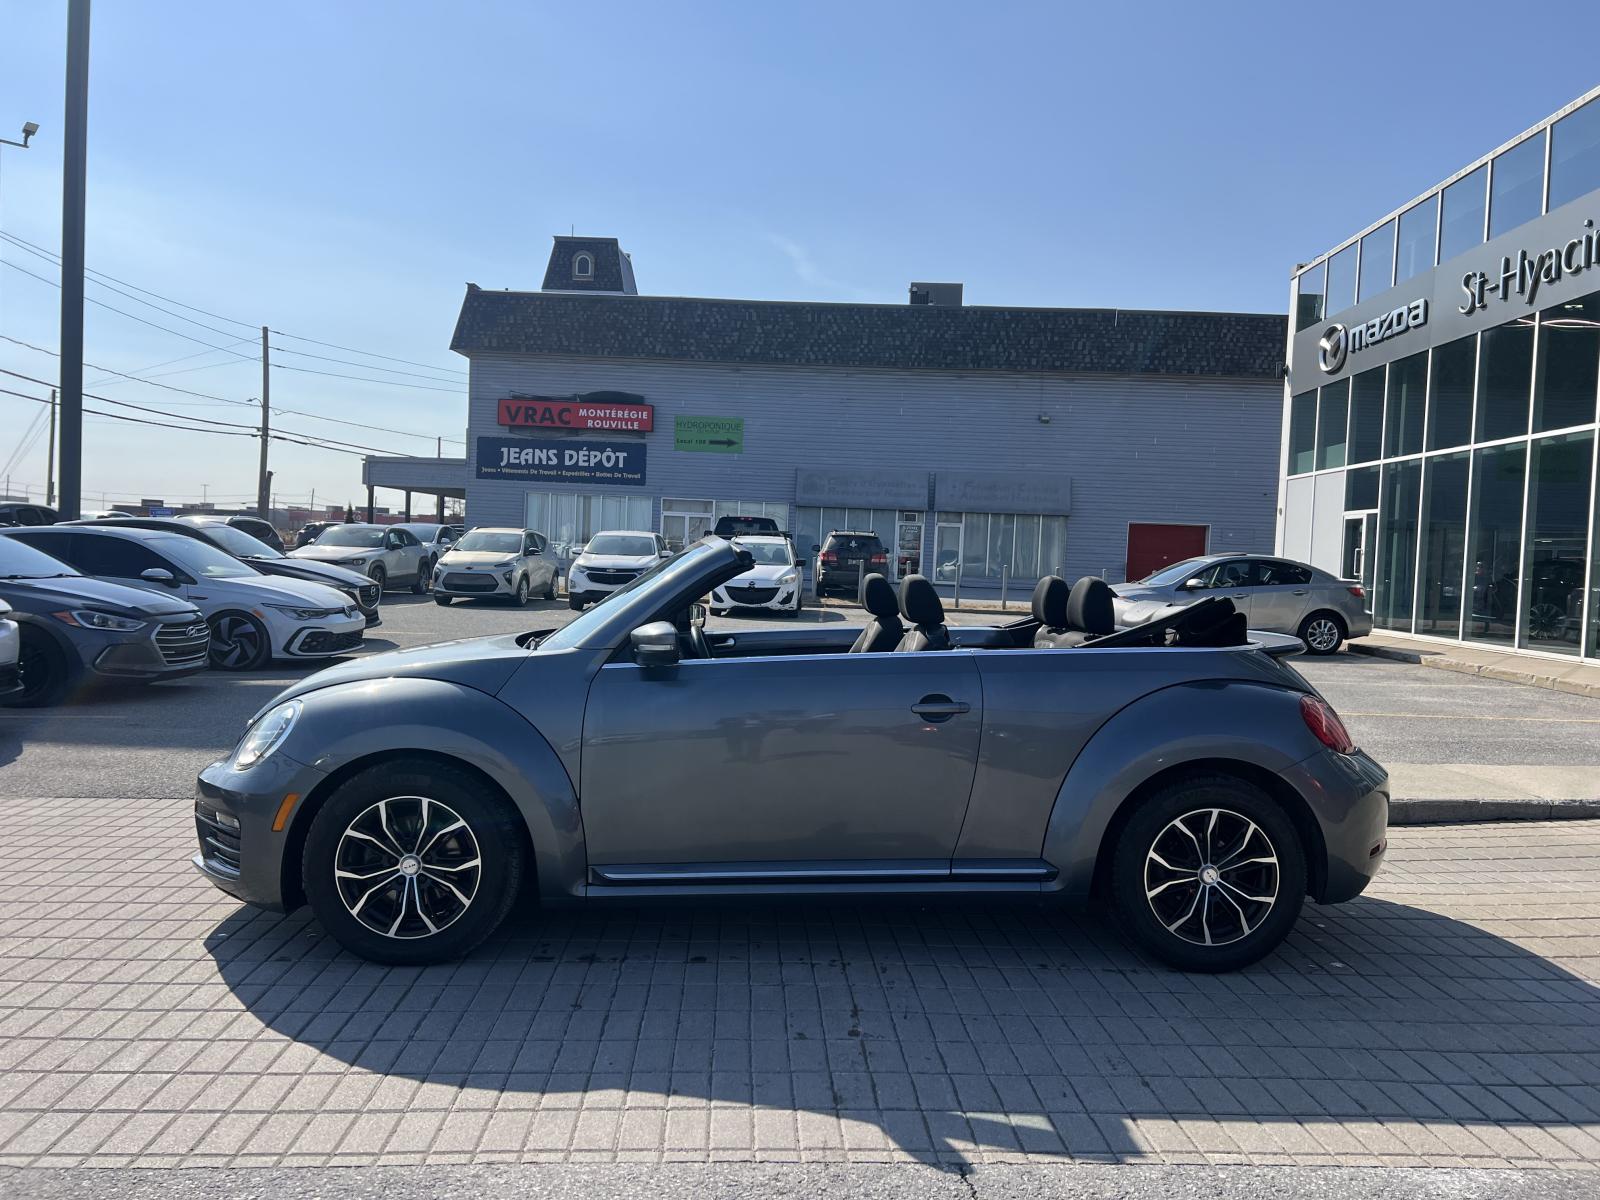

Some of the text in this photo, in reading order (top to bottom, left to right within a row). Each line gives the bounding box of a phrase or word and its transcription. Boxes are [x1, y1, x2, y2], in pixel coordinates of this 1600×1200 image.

[1350, 299, 1428, 352] mazda
[505, 405, 572, 425] VRAC
[579, 408, 648, 419] MONTÉRÉGIE
[587, 419, 640, 430] ROUVILLE
[500, 446, 628, 468] JEANS DÉPÔT
